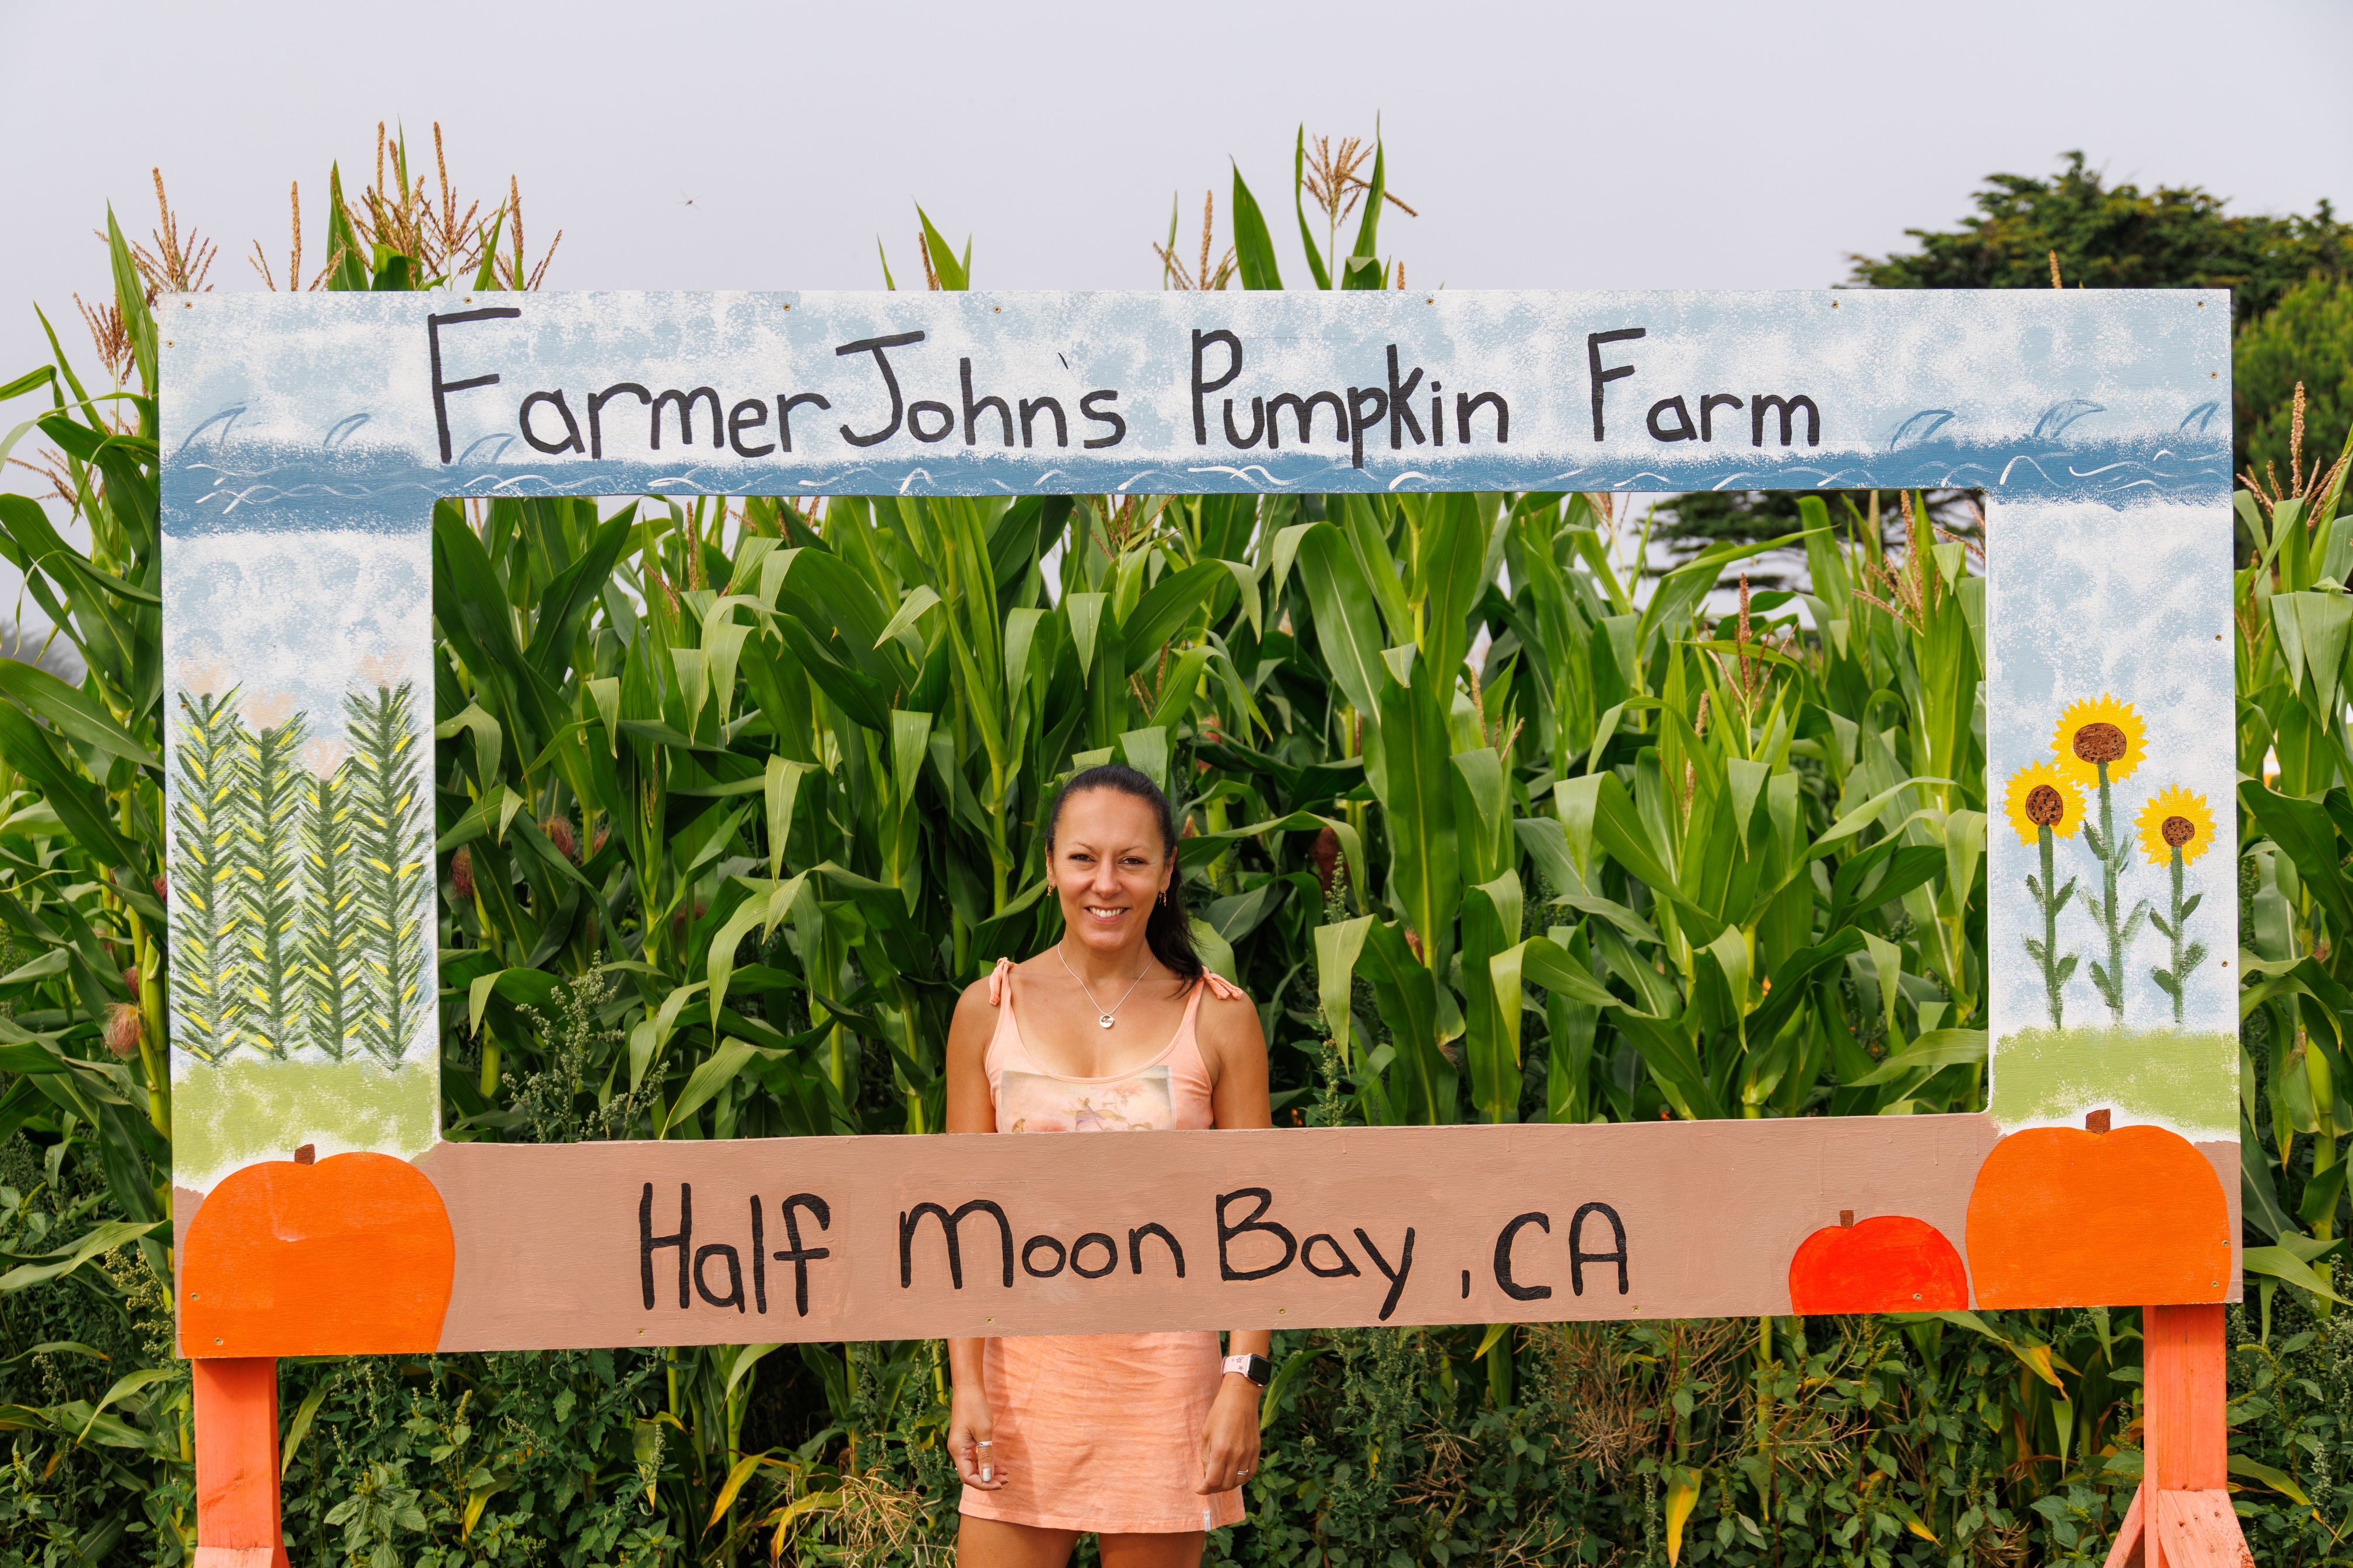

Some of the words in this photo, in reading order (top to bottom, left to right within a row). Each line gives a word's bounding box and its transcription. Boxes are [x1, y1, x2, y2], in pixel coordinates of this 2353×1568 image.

[428, 307, 831, 463] Farmer
[835, 330, 1126, 449] John's
[1191, 328, 1509, 469] Pumpkin
[1588, 327, 1820, 447] Farm
[639, 1182, 830, 1317] Half
[899, 1199, 1185, 1290] Moon
